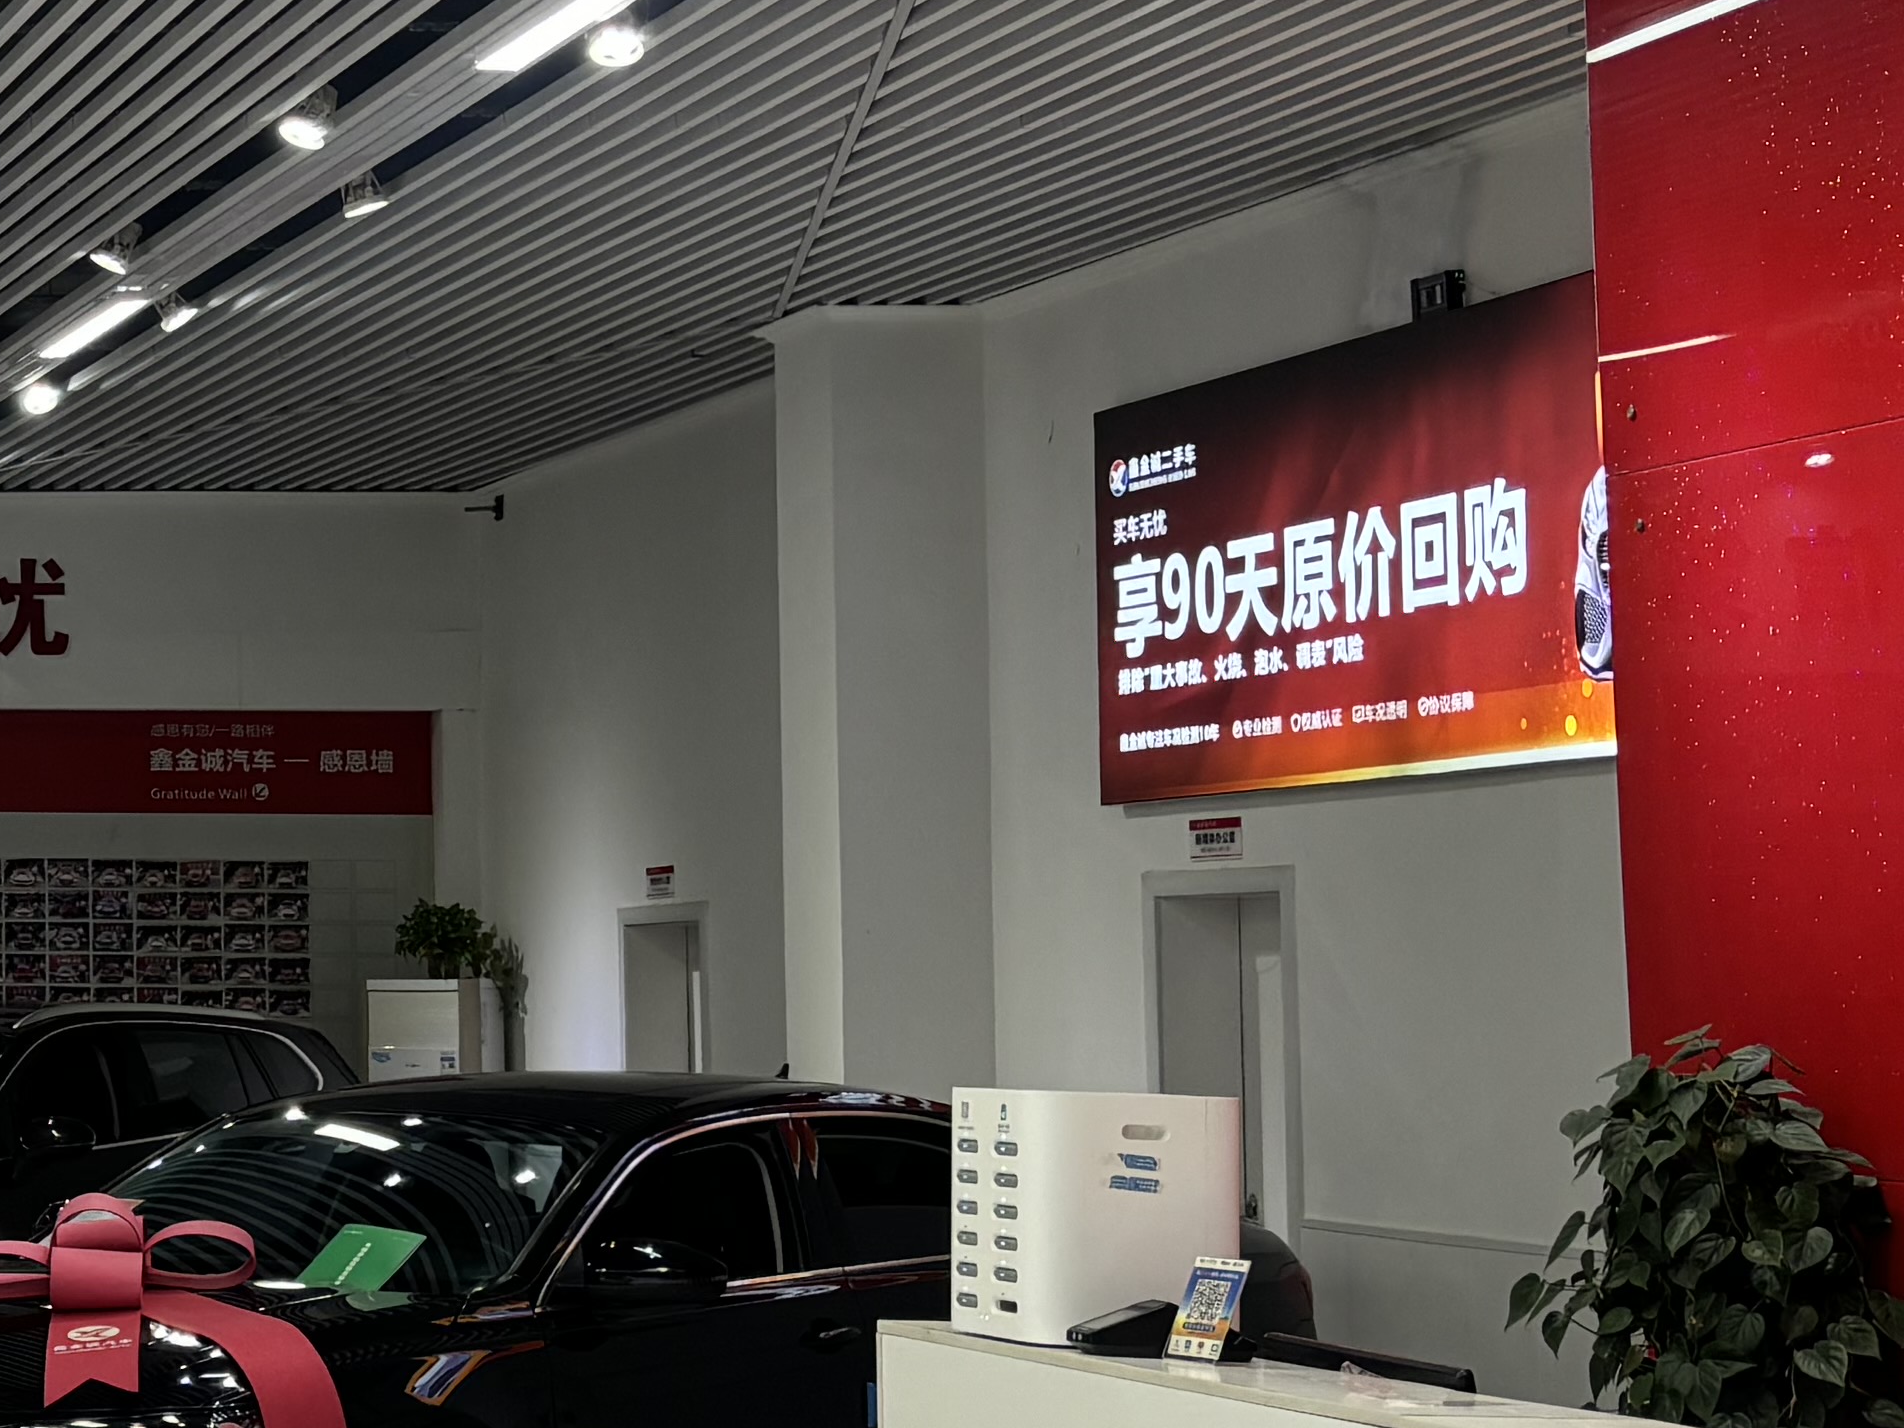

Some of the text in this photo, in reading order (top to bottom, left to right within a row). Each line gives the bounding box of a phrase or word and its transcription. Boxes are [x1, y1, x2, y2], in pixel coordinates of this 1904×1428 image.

[1113, 509, 1168, 546] 买车无忧
[1113, 477, 1527, 659] 享90天原价回购
[149, 748, 276, 773] 鑫金诚汽车
[319, 749, 394, 773] 感恩墙
[150, 786, 247, 800] Gratitude Wall
